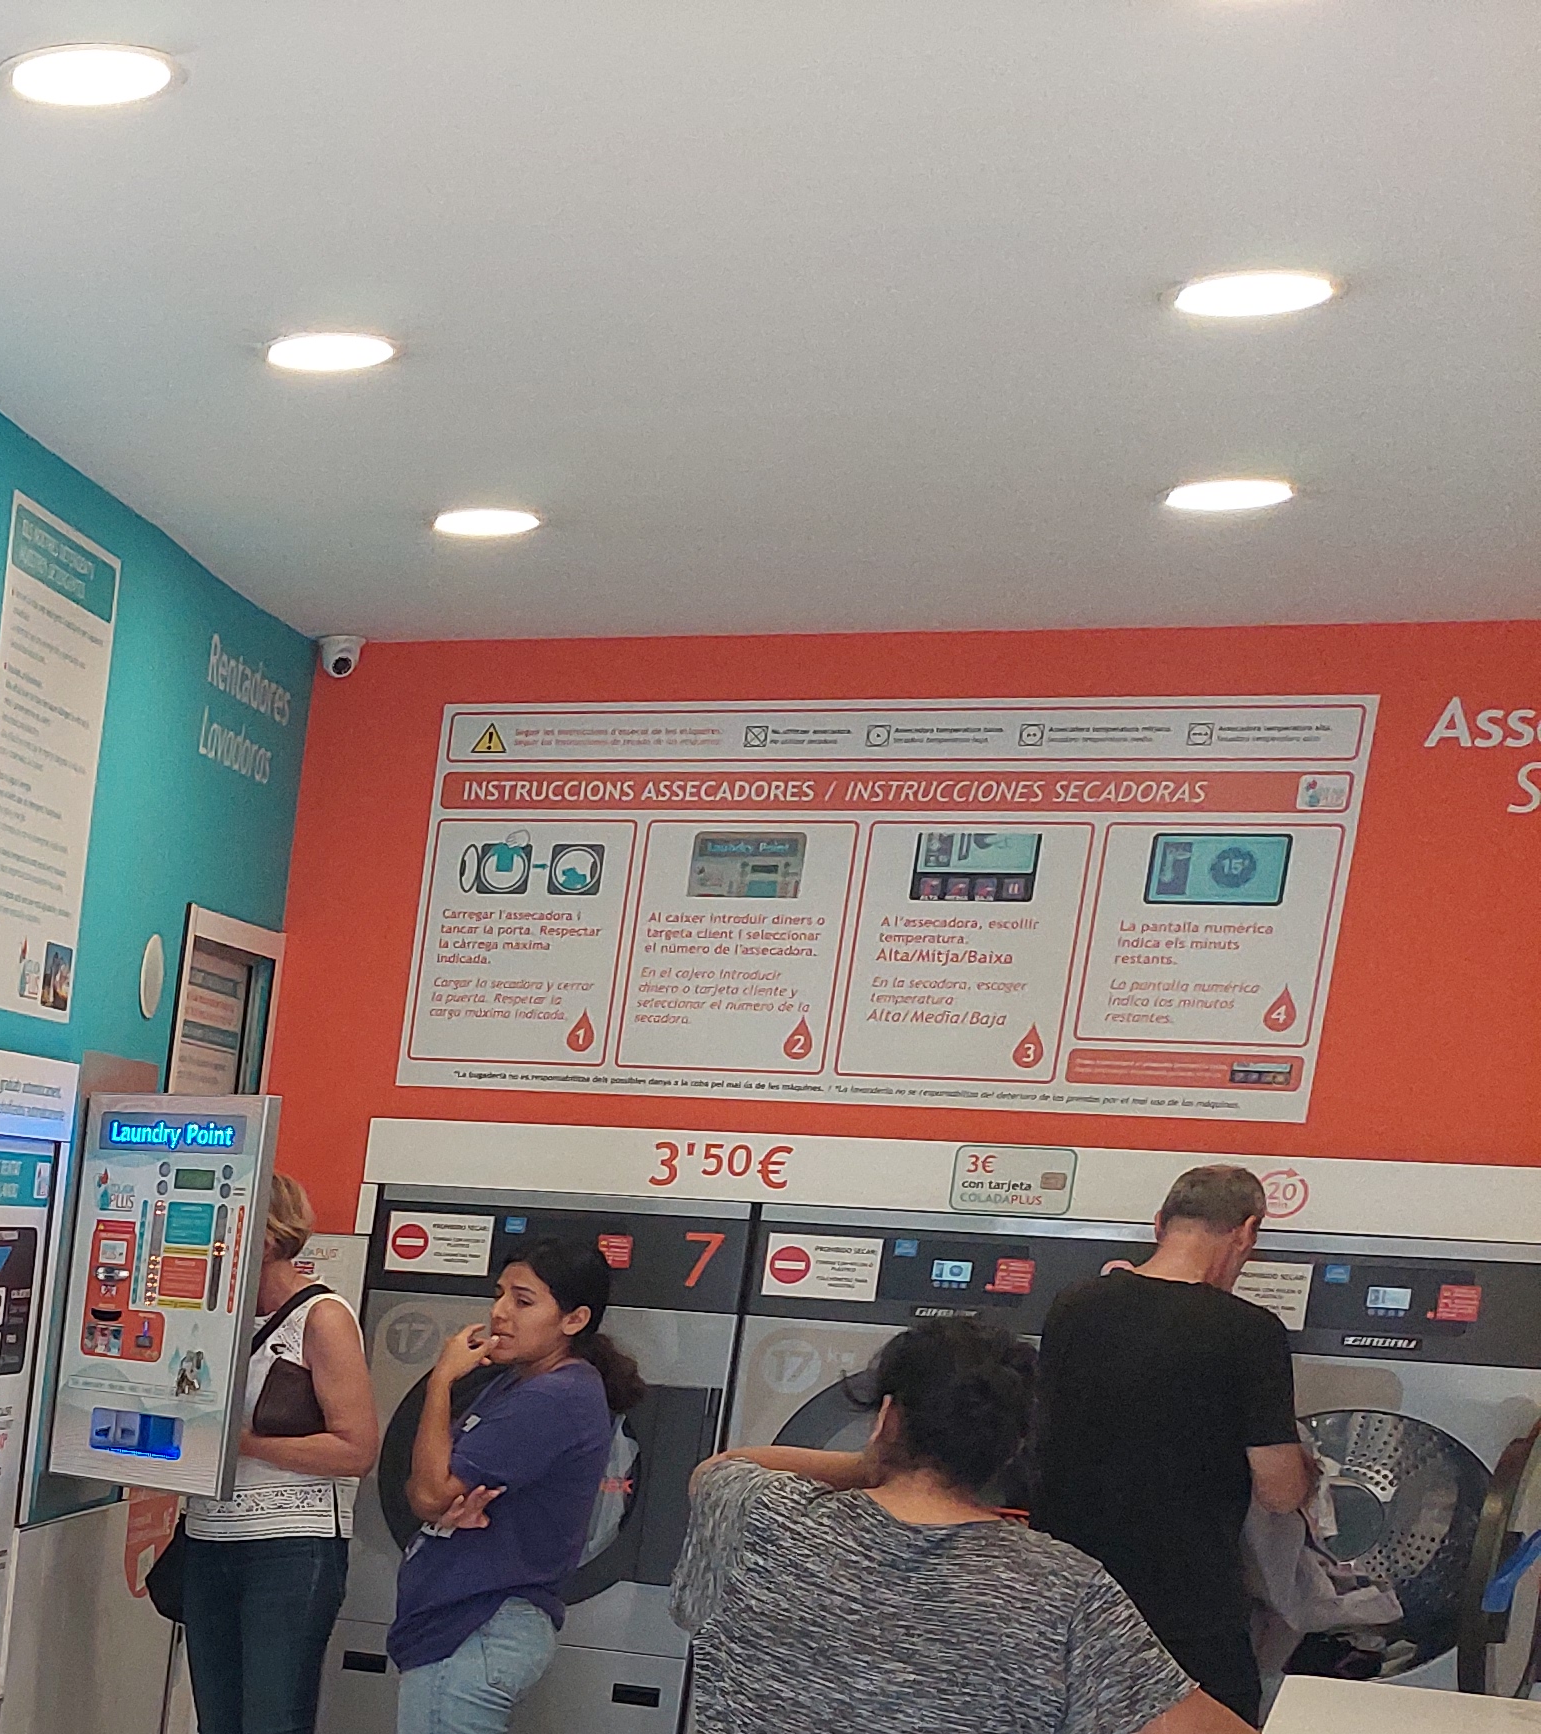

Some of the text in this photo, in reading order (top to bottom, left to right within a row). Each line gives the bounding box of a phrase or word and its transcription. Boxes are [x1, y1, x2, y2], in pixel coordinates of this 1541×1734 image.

[208, 633, 291, 727] Rentadores
[1424, 697, 1541, 747] Ass
[464, 781, 1208, 803] INSTRUCCIONS ASSECADORES / INSTRUCCIONES SECADORAS
[648, 912, 825, 925] Al caixer introduir diners o
[647, 928, 692, 940] targeta
[697, 929, 733, 939] client
[746, 929, 821, 941] seleccionar
[645, 942, 818, 956] el número de l'assecadora.
[1118, 937, 1239, 950] indica els minuts
[875, 949, 1012, 966] Alta/Mitja/Baixa
[1115, 954, 1178, 965] restants.
[111, 1121, 234, 1148] Laundry Point
[649, 1142, 793, 1189] 3'50€
[967, 1155, 997, 1173] 3€
[988, 1180, 1032, 1192] tarjeta
[960, 1191, 1042, 1205] COLADAPLUS
[685, 1232, 725, 1286] 7
